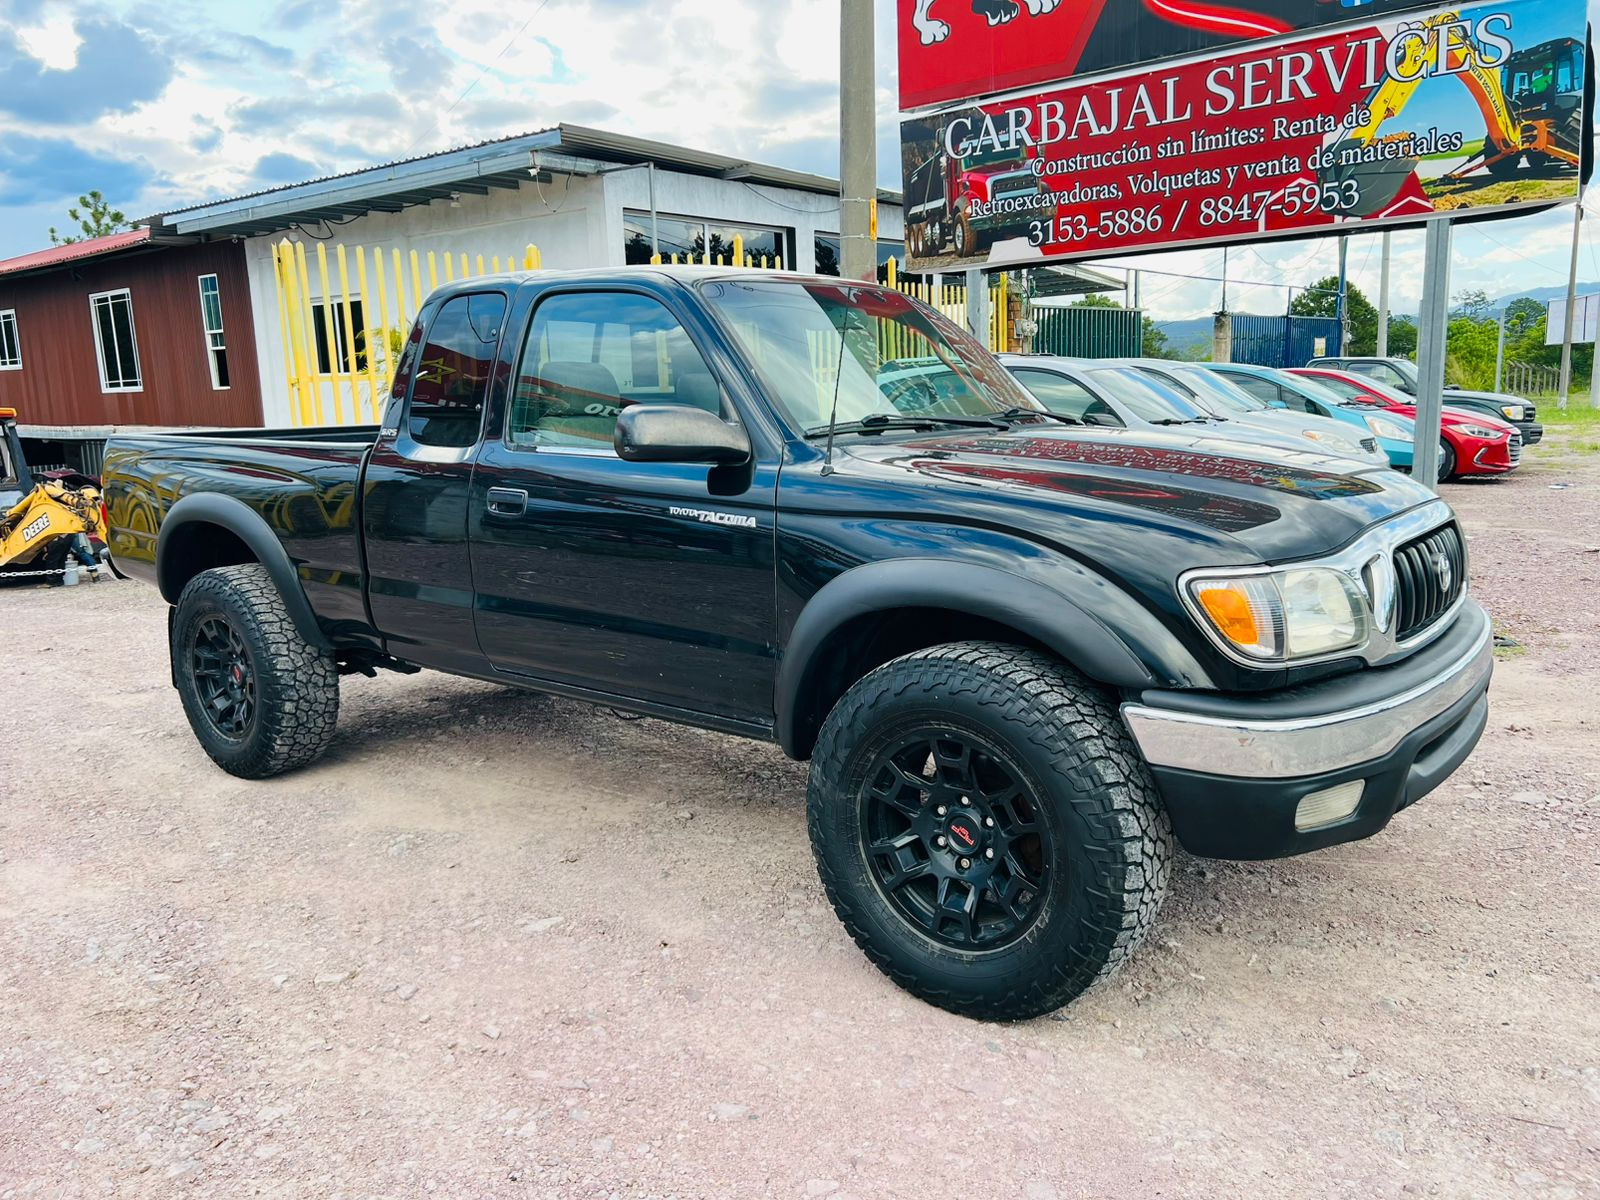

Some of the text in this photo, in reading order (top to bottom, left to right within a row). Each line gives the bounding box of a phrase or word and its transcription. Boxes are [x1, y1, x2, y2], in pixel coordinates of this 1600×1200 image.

[943, 76, 1192, 160] CARBAJAL
[1204, 13, 1512, 116] SERVICES
[970, 128, 1463, 217] Retroexcavadoras, Volquetas y venta de materiales
[1031, 103, 1372, 177] Construcción sin límites: Renta de
[1028, 180, 1360, 247] 3153-5886 / 8847-5953
[22, 512, 50, 542] DEERE
[669, 506, 756, 528] TOYOTA TACOMA
